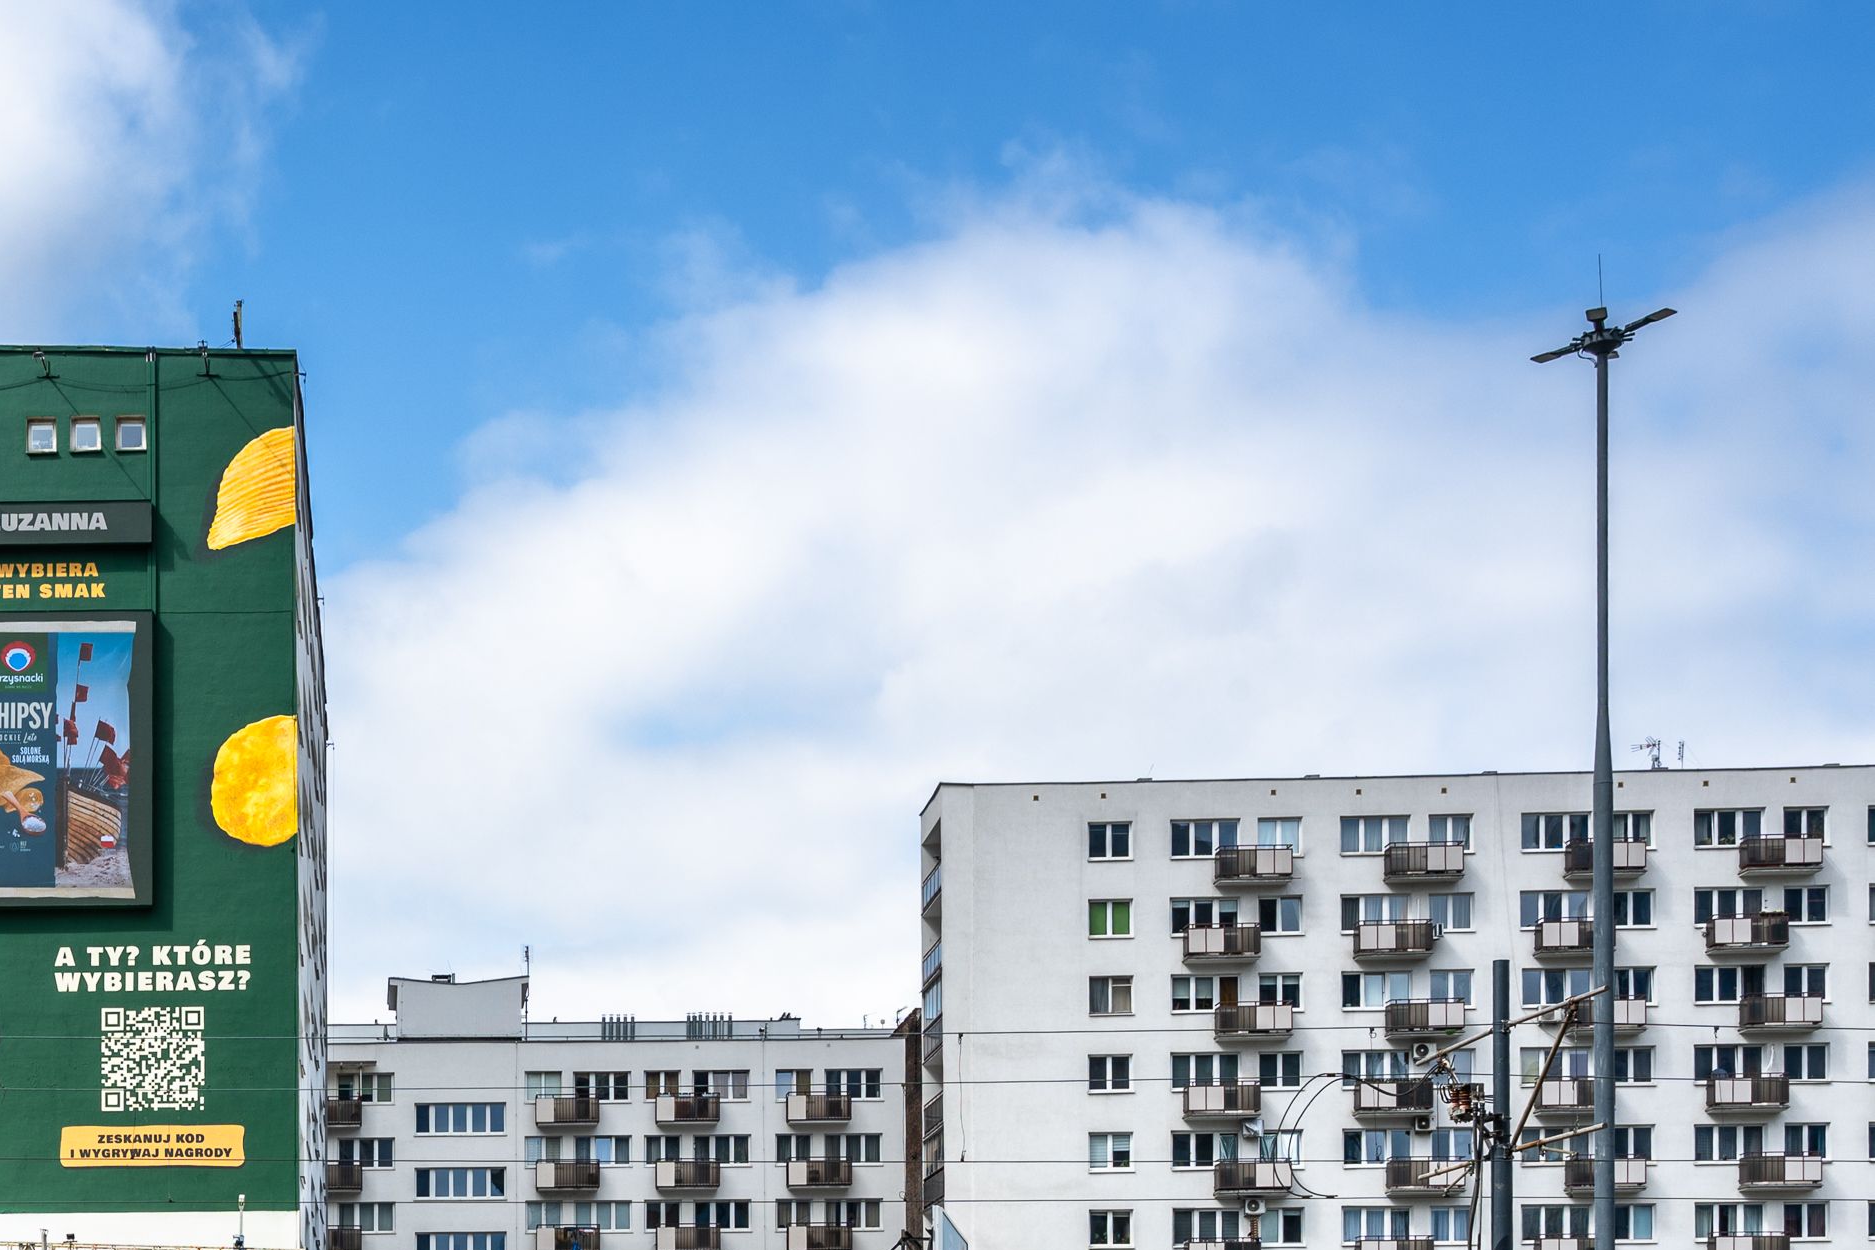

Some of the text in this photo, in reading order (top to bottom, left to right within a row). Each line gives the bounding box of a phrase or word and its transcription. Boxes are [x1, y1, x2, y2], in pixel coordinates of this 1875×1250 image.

[39, 583, 106, 598] SMAK
[54, 939, 251, 967] A TY? KTÓRE
[54, 970, 251, 992] WYBIERASZ?
[97, 1133, 205, 1144] ZESKANUJ KOD
[70, 1147, 232, 1158] I WYGRYWAJ NAGRODY
